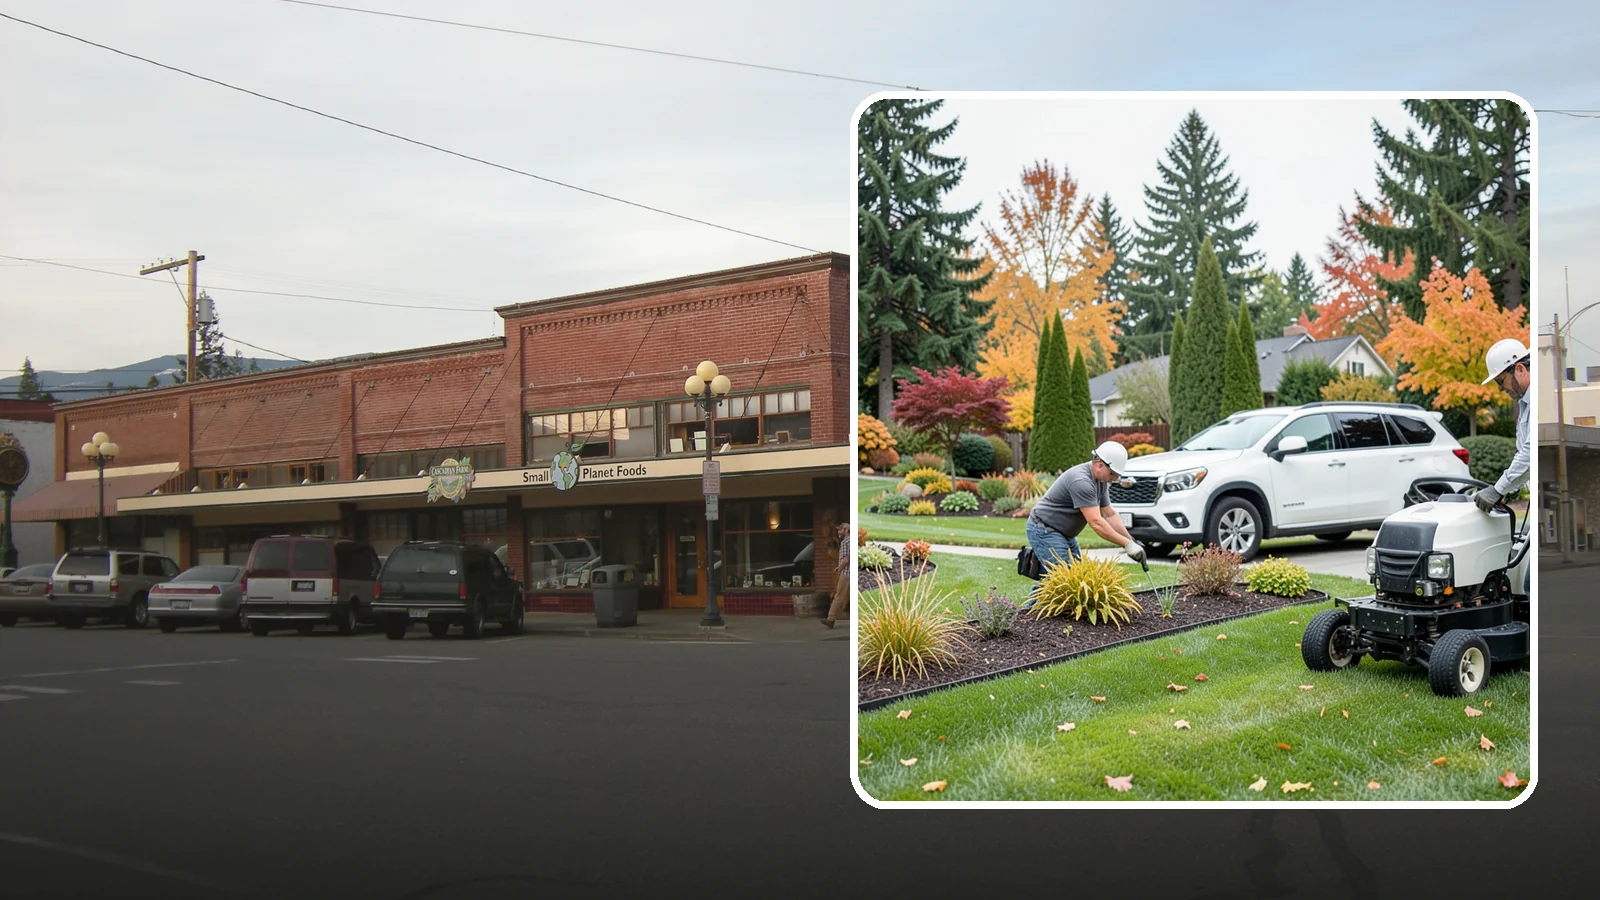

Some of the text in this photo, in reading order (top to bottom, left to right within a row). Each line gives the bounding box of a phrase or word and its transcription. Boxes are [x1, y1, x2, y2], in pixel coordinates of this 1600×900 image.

[523, 464, 647, 483] Small Planet Foods
